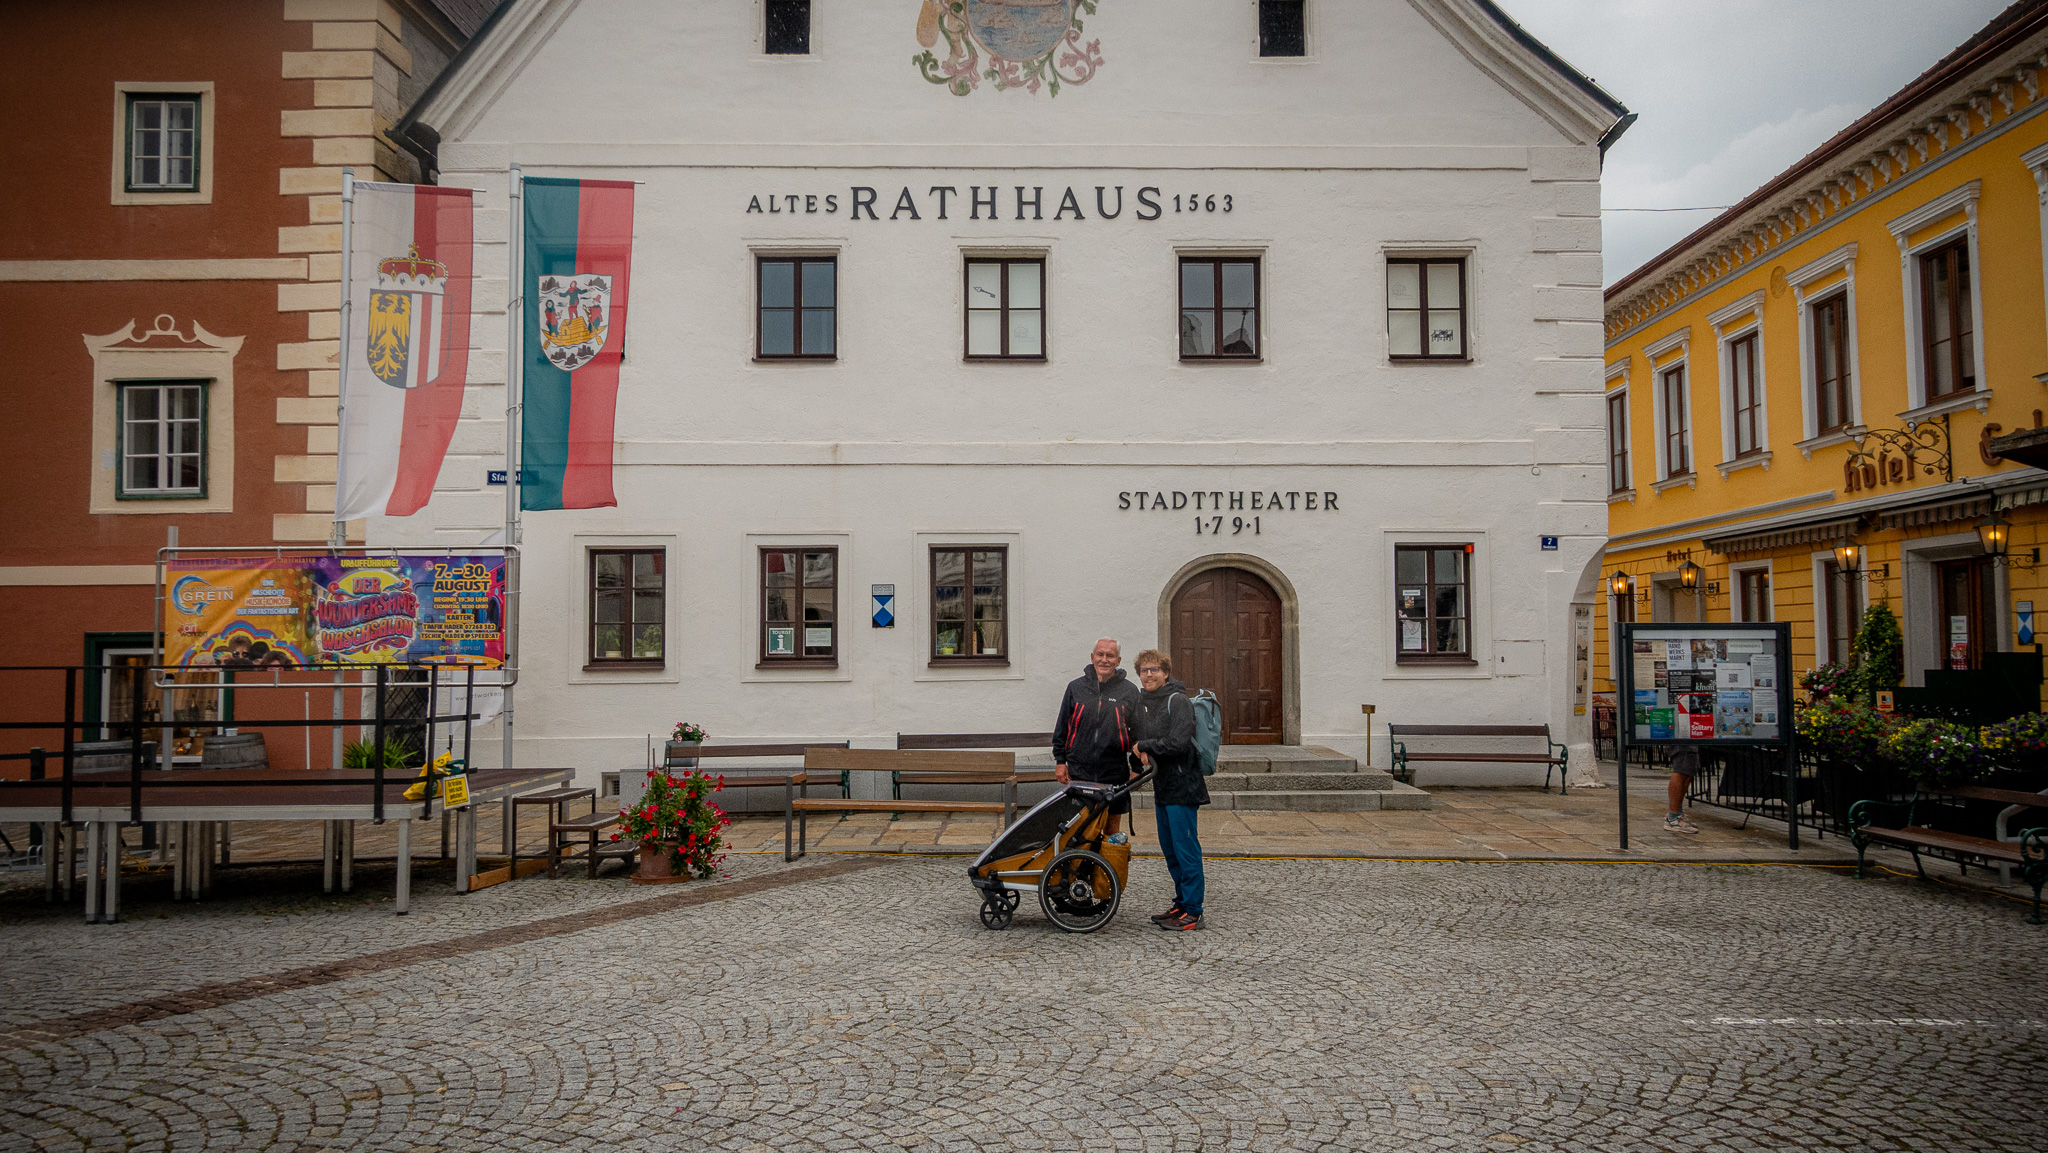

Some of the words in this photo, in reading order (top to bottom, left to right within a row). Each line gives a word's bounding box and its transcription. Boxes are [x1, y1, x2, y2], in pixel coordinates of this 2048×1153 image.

[746, 194, 838, 214] ALTES
[850, 186, 1163, 221] RATHHAUS
[1172, 194, 1234, 213] 1563
[1118, 491, 1339, 510] STADTTHEATER
[341, 557, 399, 568] URAUFFÜHRUNG!
[353, 578, 381, 594] DER
[434, 580, 490, 592] AUGUST
[182, 591, 233, 601] GREIN
[321, 618, 414, 651] WASCHSALON
[1691, 724, 1714, 732] Solitary
